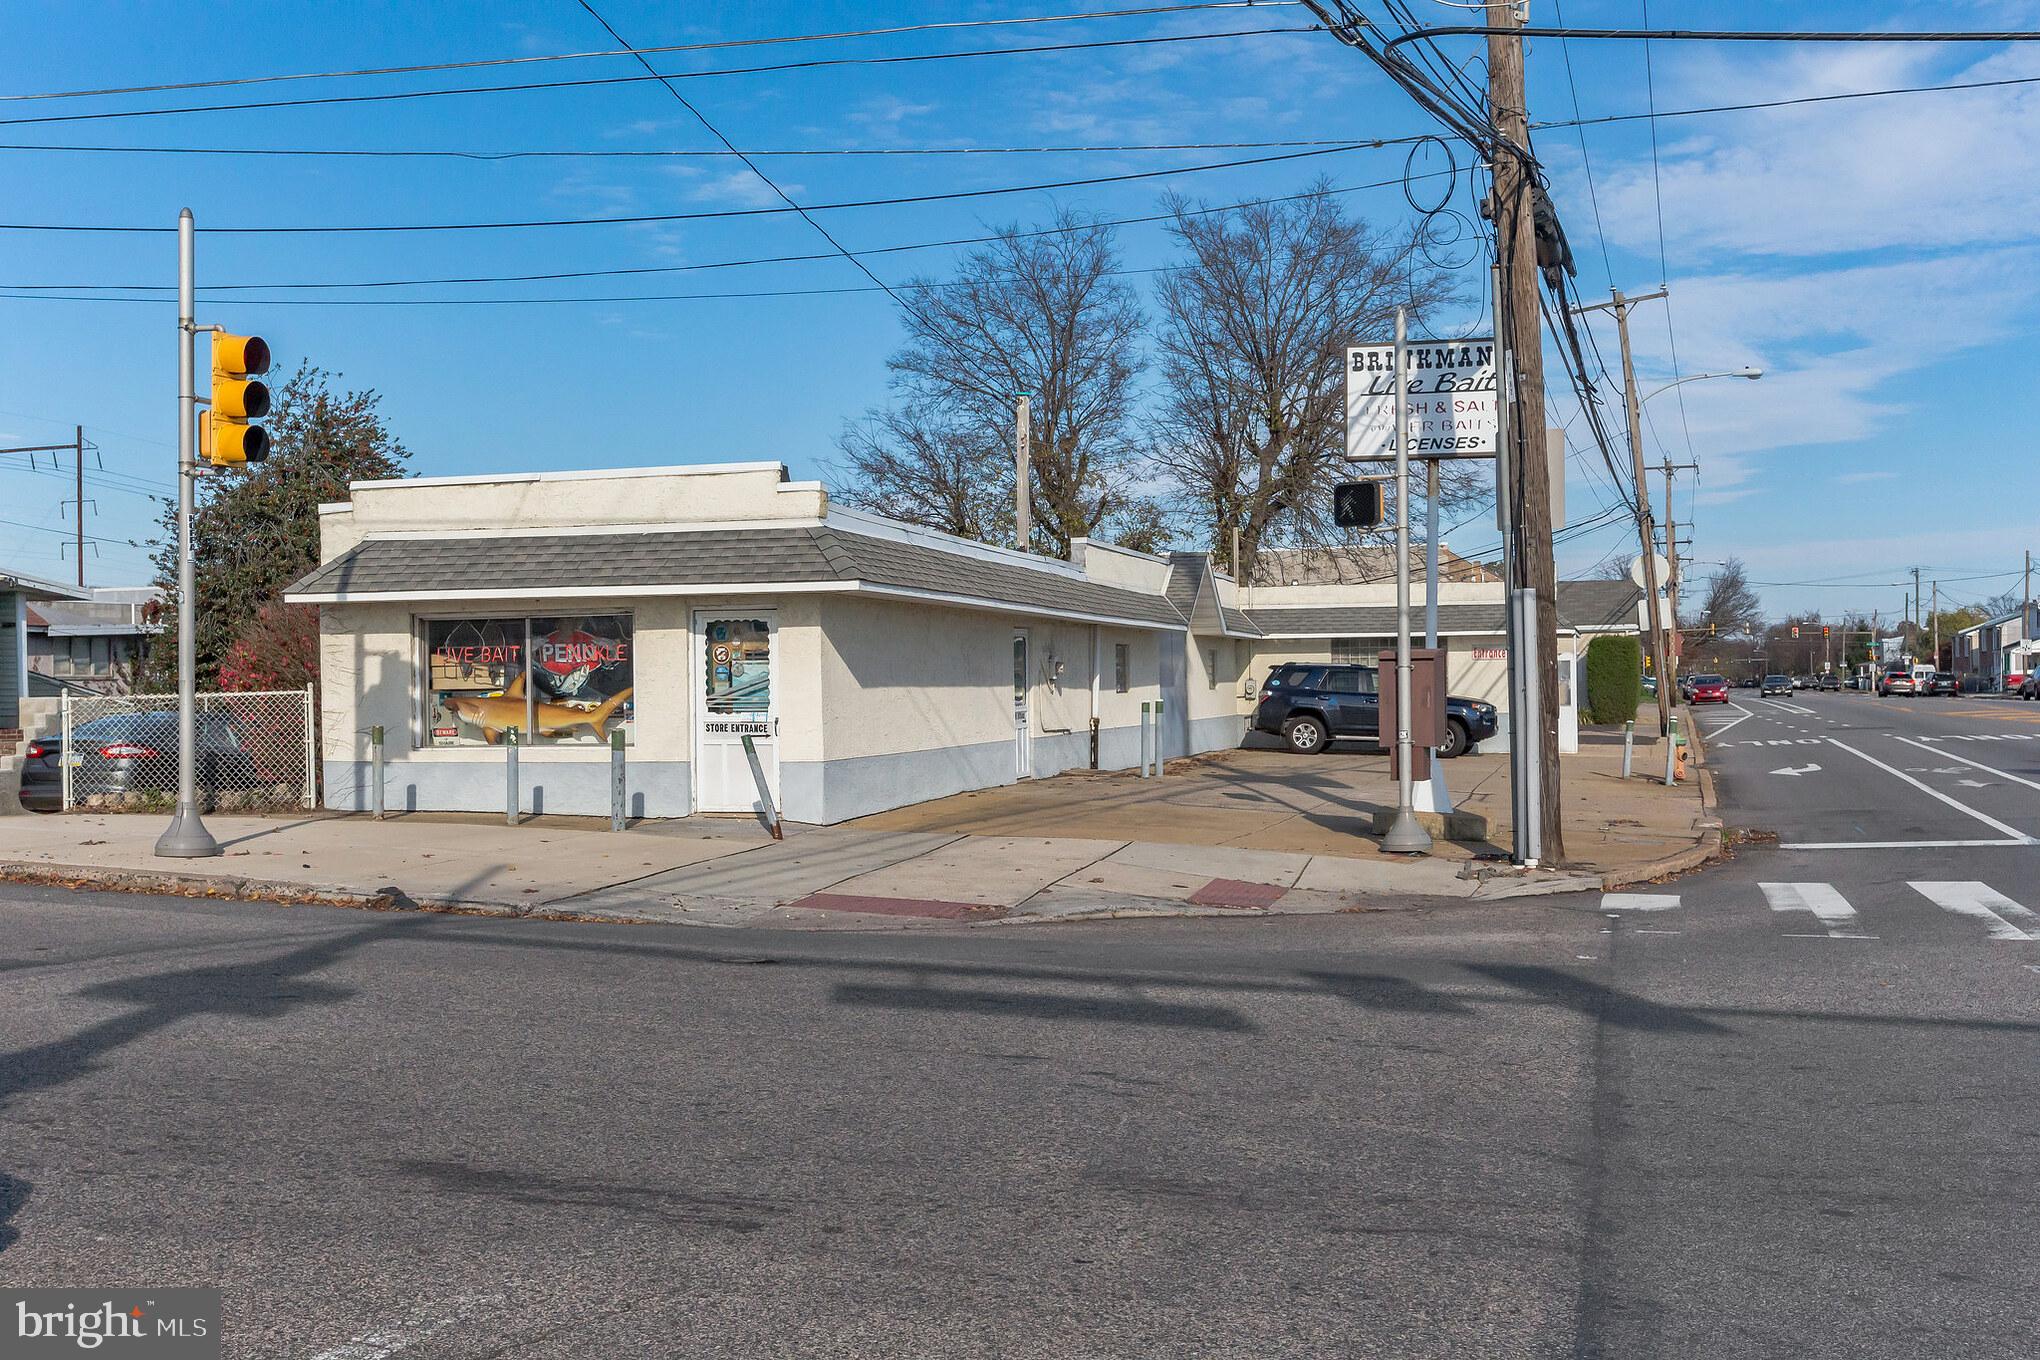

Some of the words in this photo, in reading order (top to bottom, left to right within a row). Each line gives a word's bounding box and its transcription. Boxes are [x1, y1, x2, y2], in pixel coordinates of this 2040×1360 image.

[1366, 401, 1428, 416] RSH
[1435, 401, 1447, 413] &
[1389, 436, 1480, 451] LCENSES
[481, 646, 520, 663] BAIT
[706, 723, 728, 733] STORE
[731, 723, 768, 733] ENTRANCE
